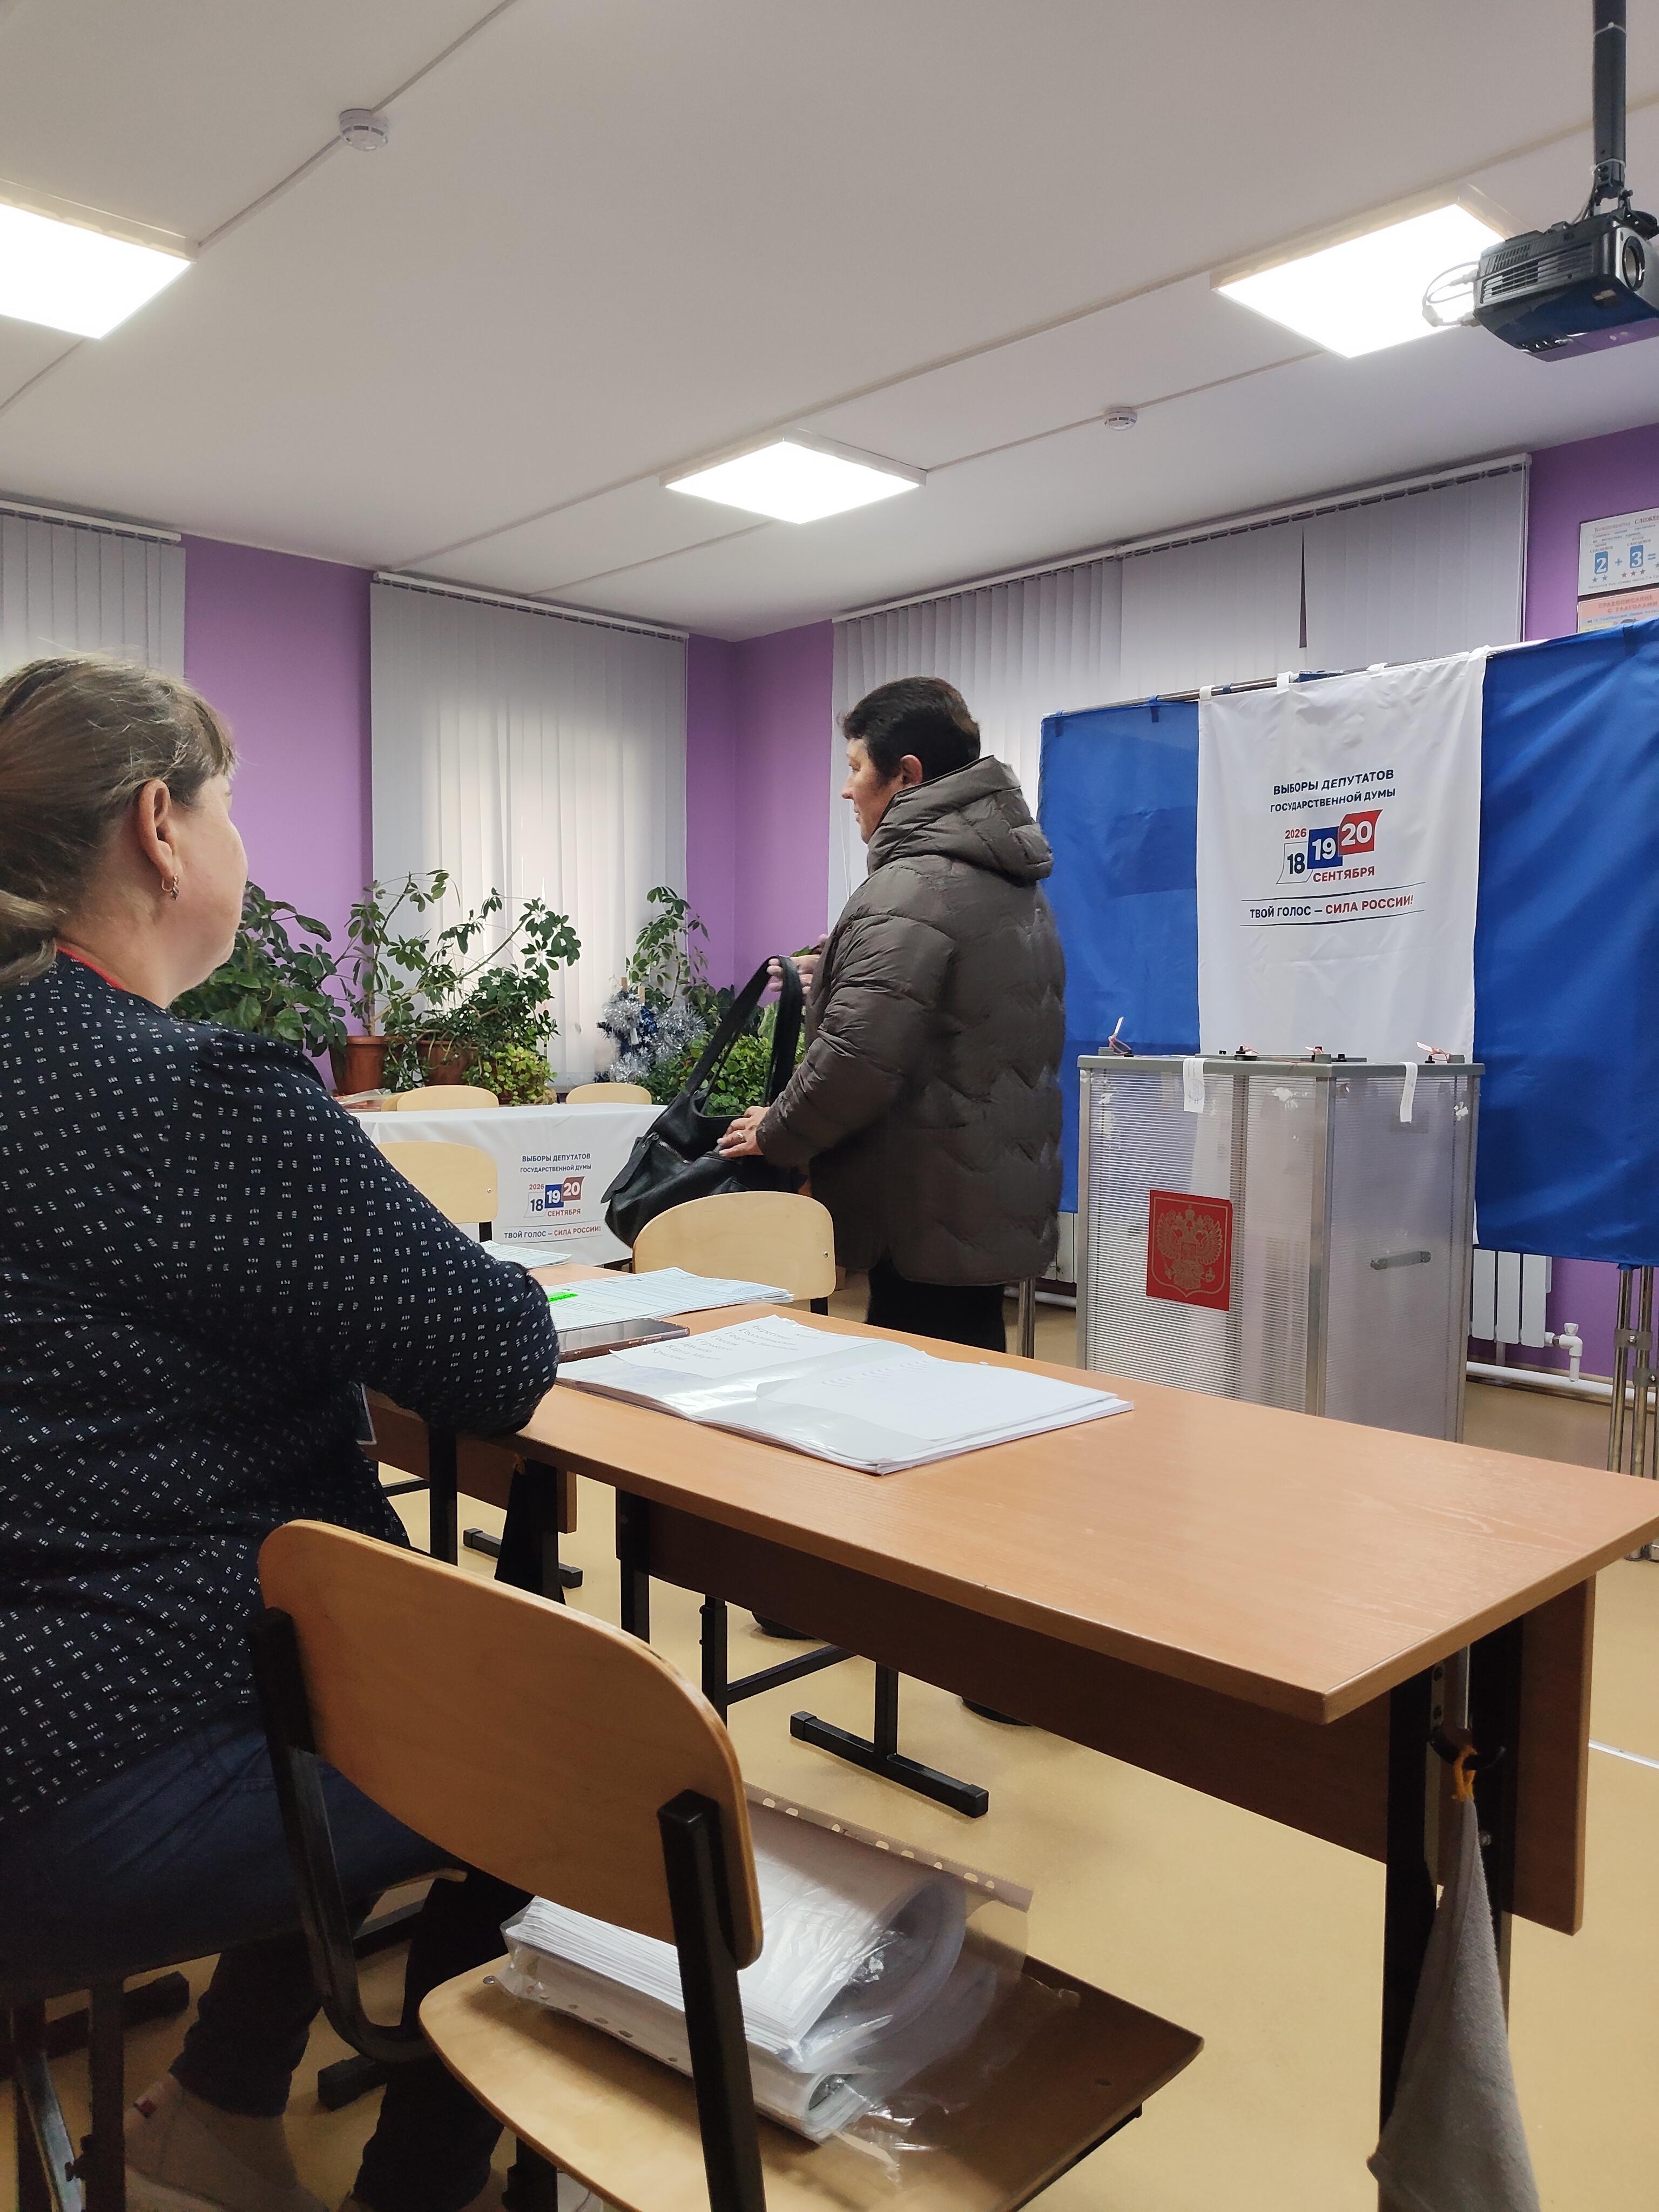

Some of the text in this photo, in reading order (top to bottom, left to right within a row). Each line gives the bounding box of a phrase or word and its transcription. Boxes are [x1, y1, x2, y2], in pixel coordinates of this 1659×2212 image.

[1596, 557, 1607, 572] 2
[1632, 551, 1642, 567] 3
[1273, 769, 1394, 795] ВЫБОРЫ ДЕПУТАТОВ
[1270, 788, 1396, 812] ГОСУДАРСТВЕННОЙ ДУМЫ
[1285, 828, 1307, 839] 2026
[1287, 820, 1373, 874] 18 19 20
[1313, 866, 1375, 883] СЕНТЯБРЯ
[1250, 905, 1274, 919] ТВОЙ
[1277, 906, 1311, 917] ГОЛОС
[1325, 902, 1358, 915] СИЛА
[1361, 894, 1414, 911] РОССИИ!
[552, 1153, 591, 1162] ДЕПУТАТОВ
[520, 1165, 574, 1173] ГОСУДАРСТВЕННОЙ
[530, 1182, 580, 1211] 18 19 20
[548, 1209, 581, 1217] СЕНТЯБРЯ
[504, 1230, 522, 1238] ТВОЙ
[573, 1225, 601, 1234] РОССИИ!
[696, 1338, 733, 1350] Горького
[710, 1335, 739, 1346] Гоголя
